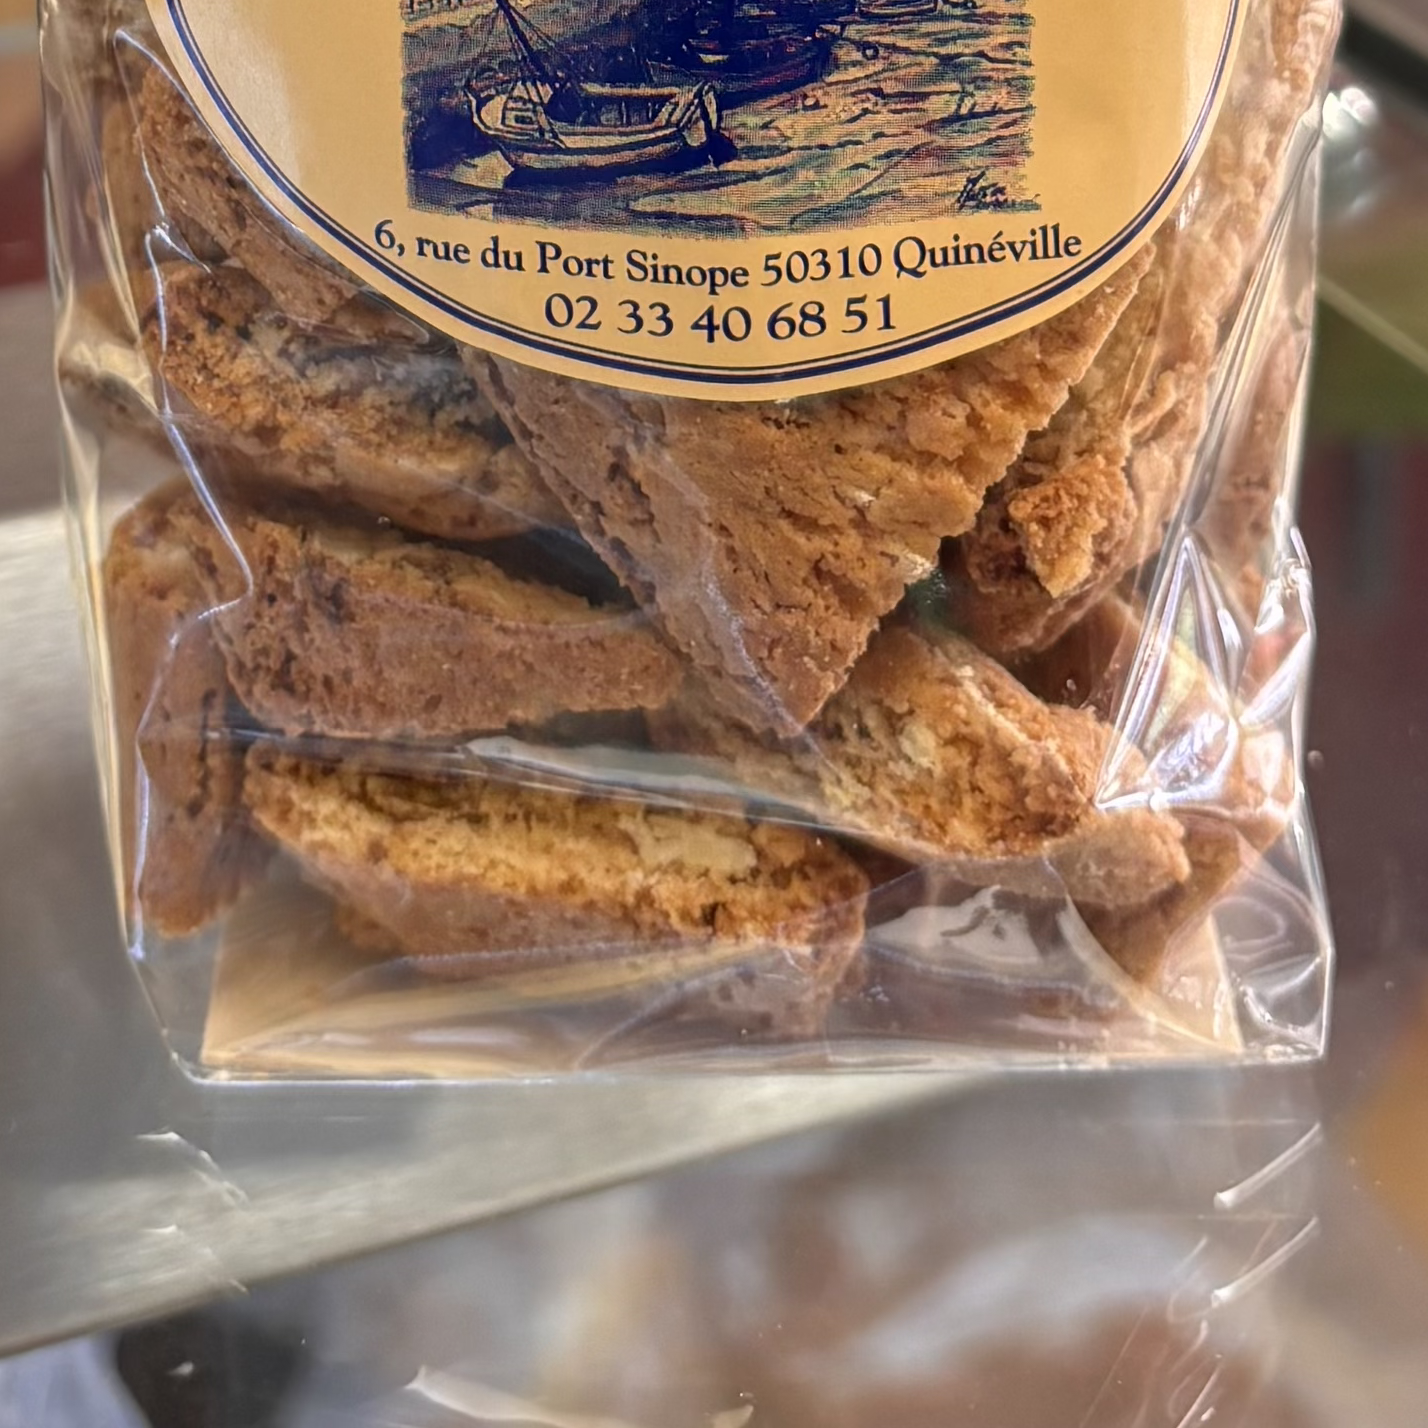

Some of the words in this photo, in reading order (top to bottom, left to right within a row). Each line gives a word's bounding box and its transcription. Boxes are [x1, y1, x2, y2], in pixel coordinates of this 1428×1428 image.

[373, 218, 407, 259] 6,
[414, 235, 472, 266] rue
[479, 234, 527, 273] du
[534, 239, 616, 282] Port
[624, 248, 752, 297] Sinope
[760, 241, 884, 288] 50310
[892, 224, 1083, 280] Quinéville
[543, 291, 604, 332] 02
[616, 298, 675, 338] 33
[689, 304, 753, 345] 40
[766, 300, 828, 342] 68
[840, 293, 898, 335] 51
